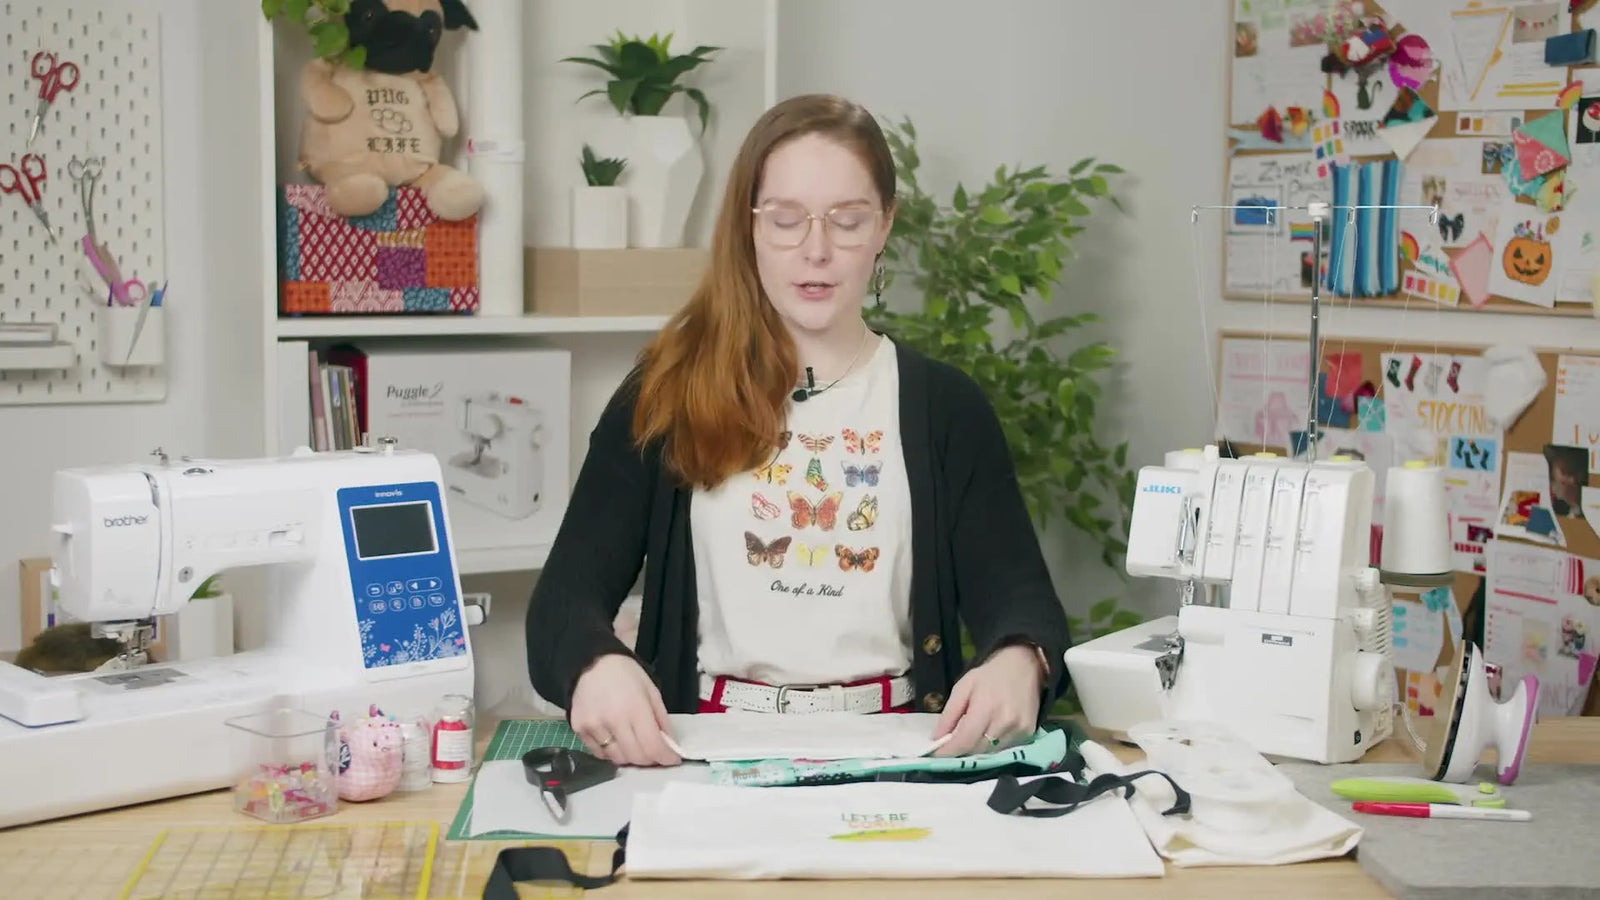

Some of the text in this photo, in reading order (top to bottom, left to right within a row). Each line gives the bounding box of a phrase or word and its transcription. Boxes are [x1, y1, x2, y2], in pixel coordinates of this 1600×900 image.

[366, 88, 409, 106] PUG
[386, 384, 429, 400] Puggle
[1142, 484, 1182, 494] JUKI
[104, 513, 149, 528] brother
[770, 579, 790, 593] One
[791, 582, 807, 597] of
[816, 583, 845, 597] Kind
